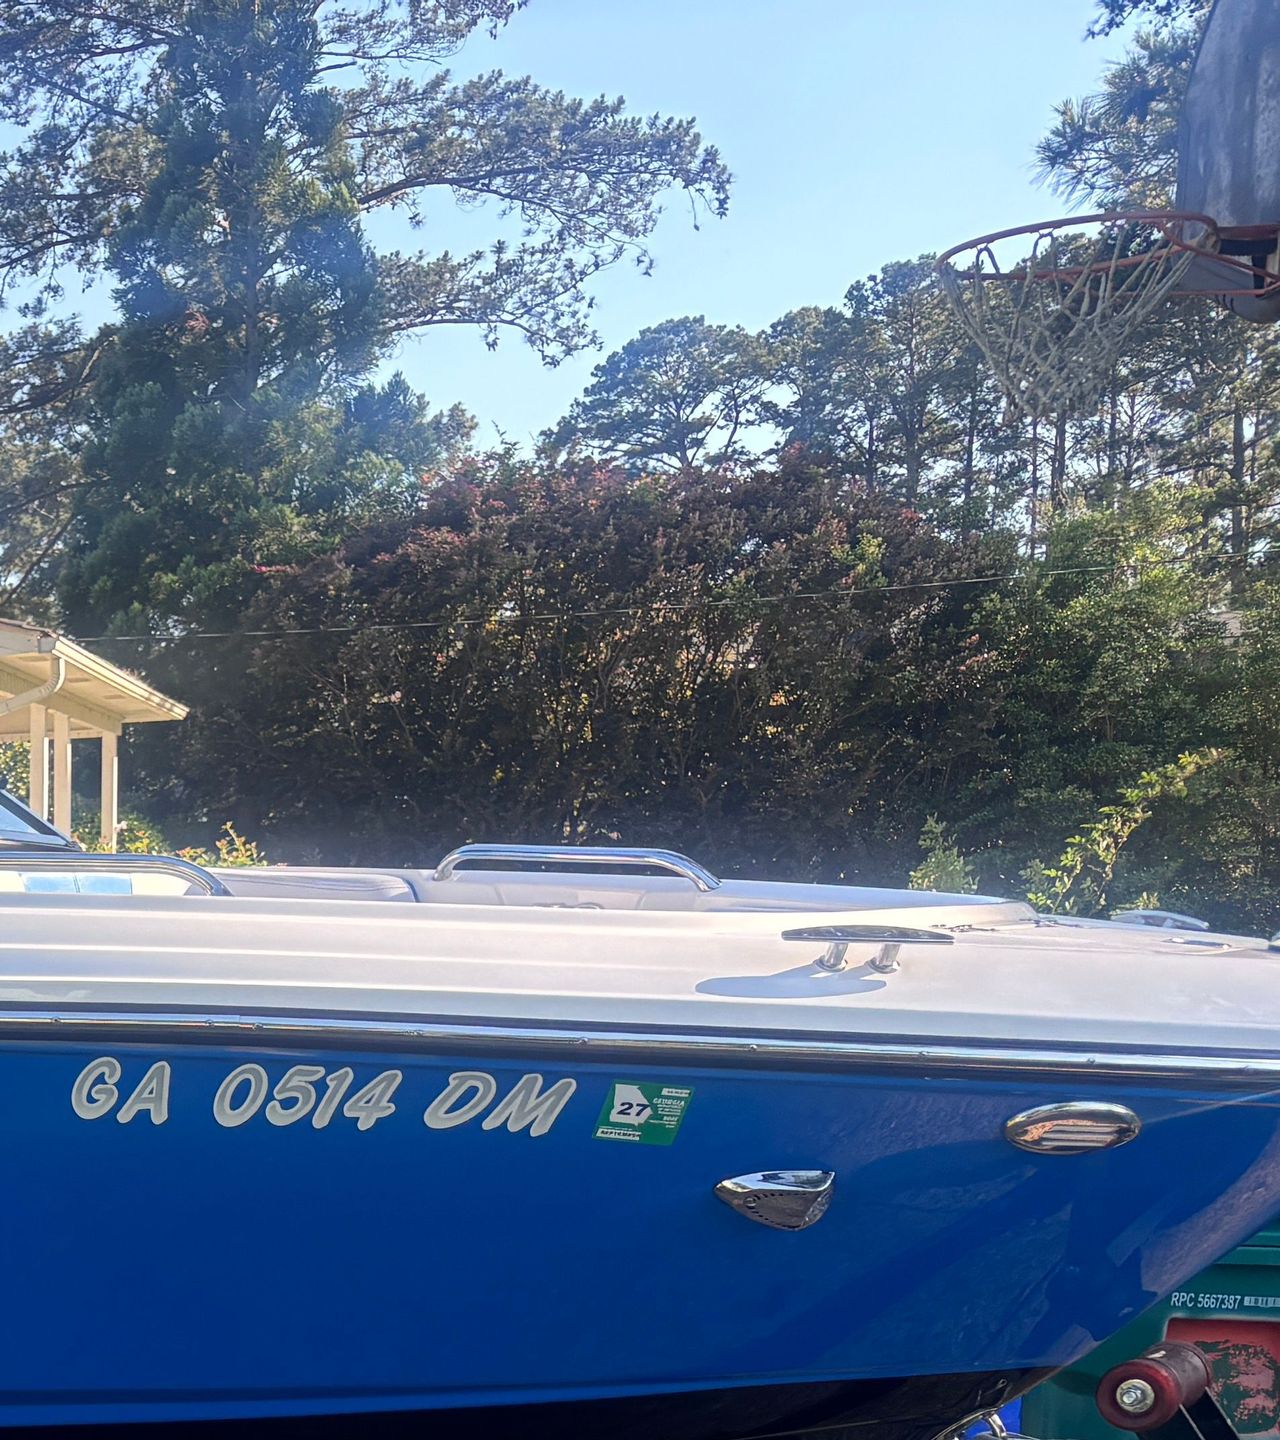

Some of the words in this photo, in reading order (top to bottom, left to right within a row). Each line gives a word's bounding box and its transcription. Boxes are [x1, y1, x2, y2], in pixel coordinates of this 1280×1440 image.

[70, 1056, 170, 1125] GA
[213, 1063, 403, 1131] 0514
[423, 1069, 577, 1137] DM
[617, 1101, 650, 1117] 27
[1171, 1292, 1195, 1307] RPC
[1197, 1294, 1241, 1309] 5667387
